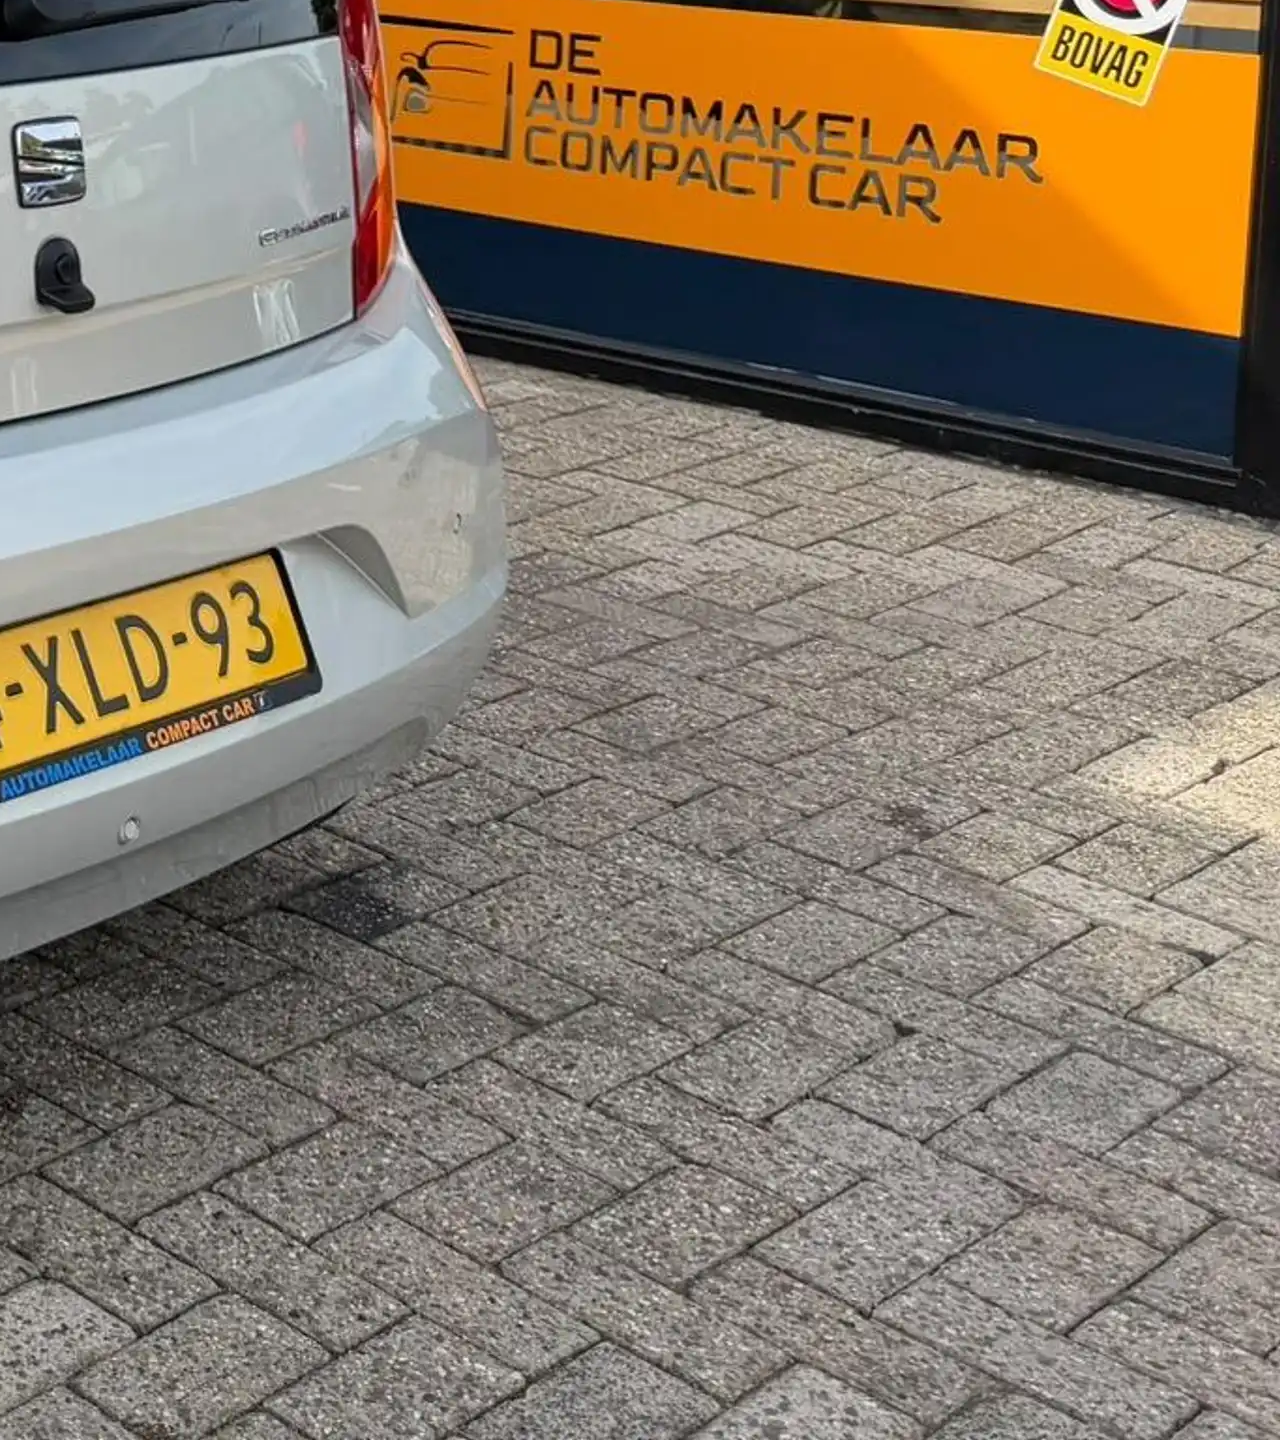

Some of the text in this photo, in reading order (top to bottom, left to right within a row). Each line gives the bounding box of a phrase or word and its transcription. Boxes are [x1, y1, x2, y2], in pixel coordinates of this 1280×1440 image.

[529, 29, 602, 76] DE
[1051, 25, 1149, 89] BOVAG
[523, 125, 943, 224] COMPACT CAR
[525, 79, 1045, 185] AUTOMAKELAAR
[0, 699, 256, 801] AUTOMAKELAAR COMPACT CAR
